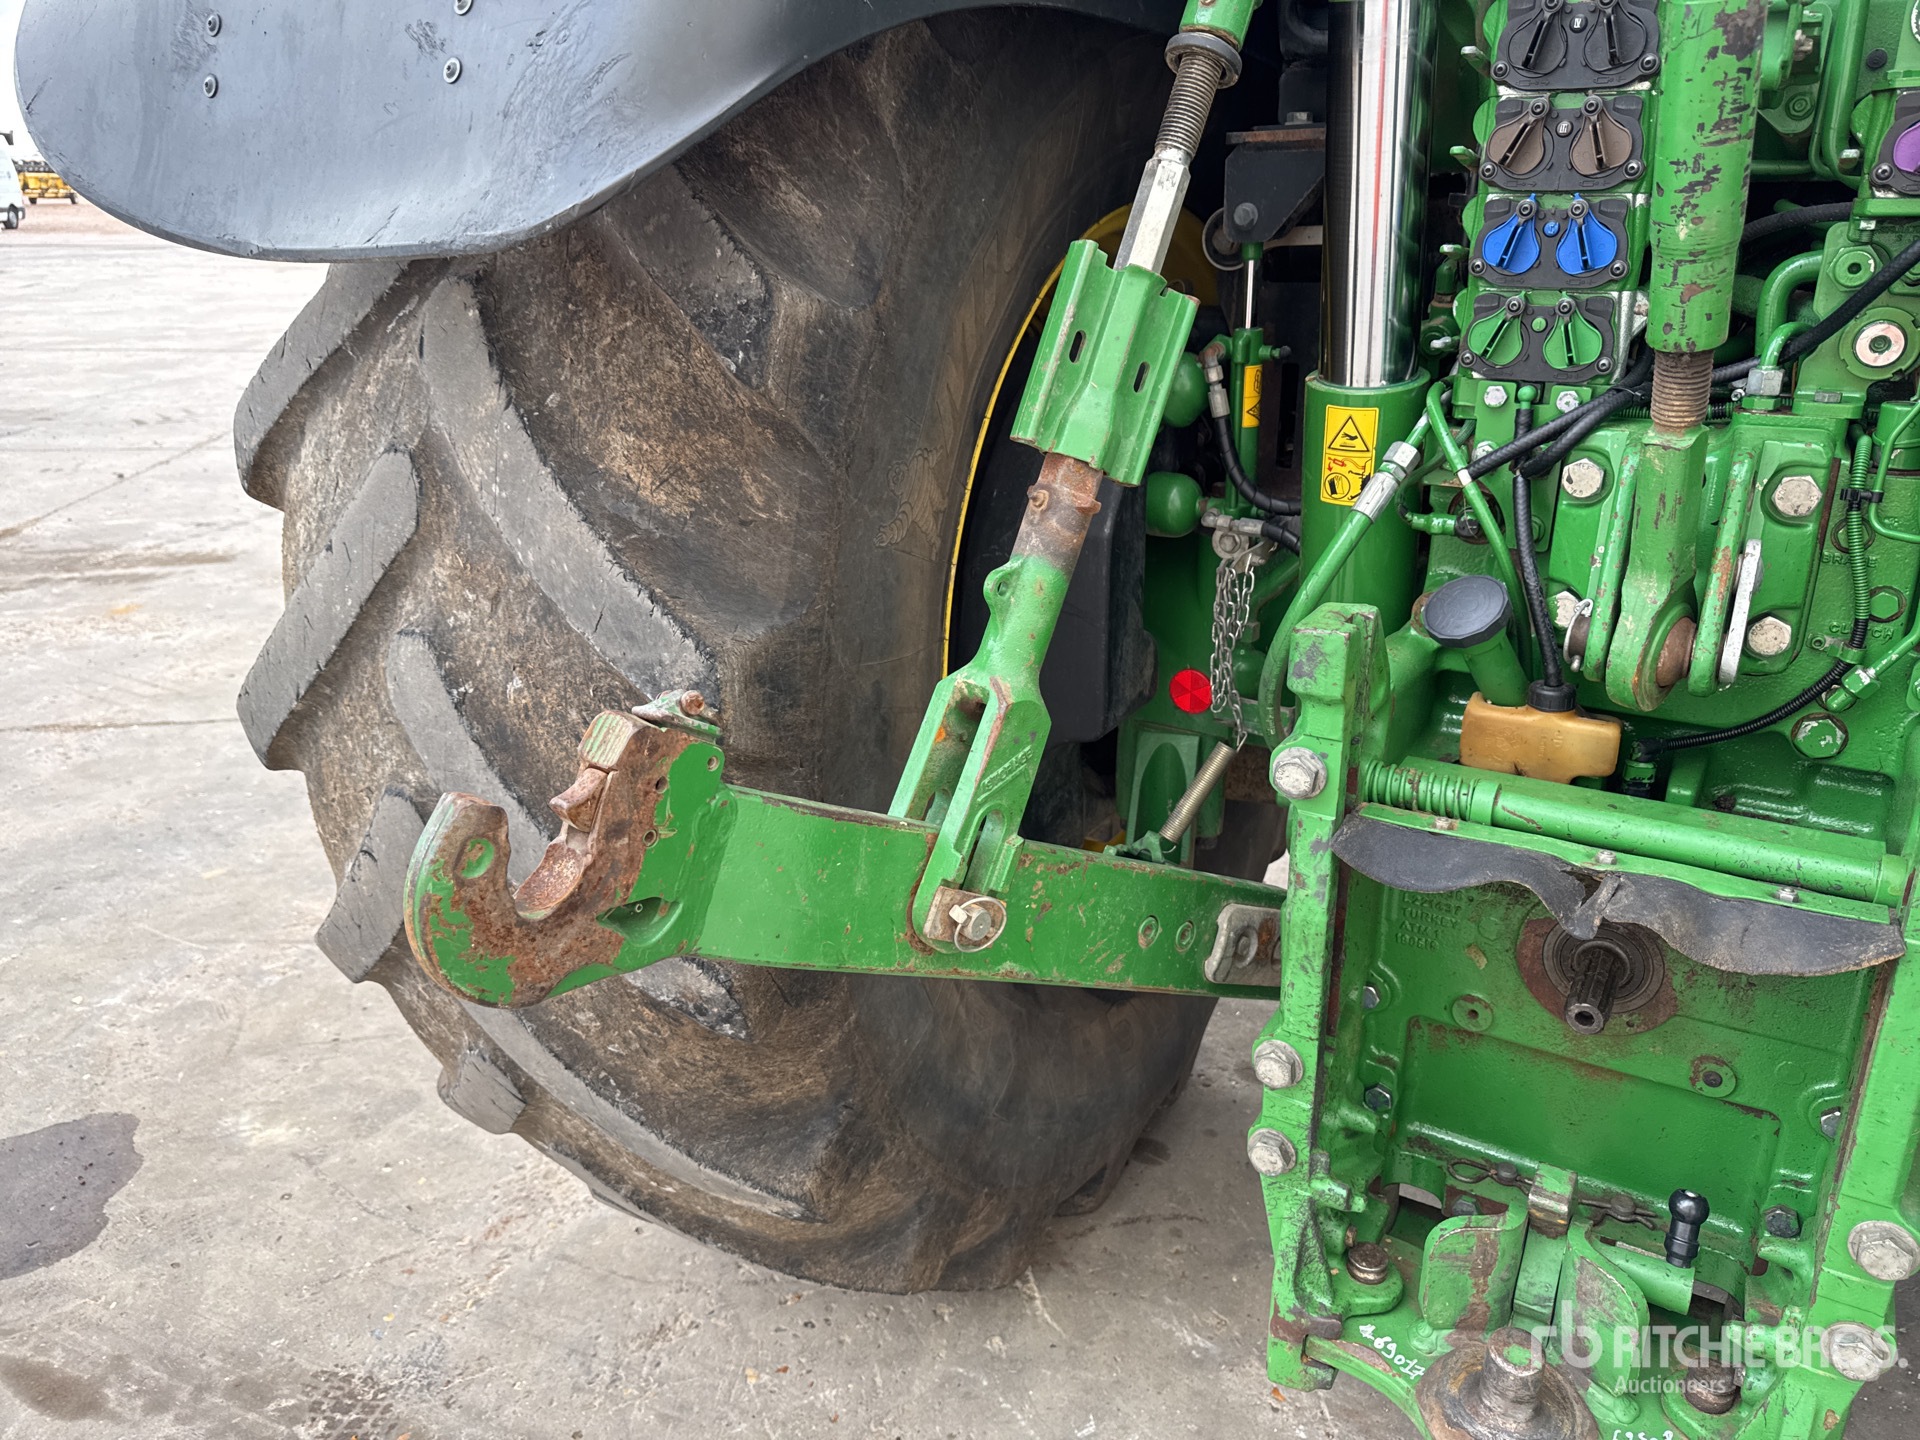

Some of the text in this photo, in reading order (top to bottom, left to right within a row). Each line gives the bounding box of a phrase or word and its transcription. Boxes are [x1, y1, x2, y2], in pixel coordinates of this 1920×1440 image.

[1821, 551, 1878, 568] BRAE
[1829, 622, 1894, 640] CLCH
[1402, 907, 1459, 929] TURKEY
